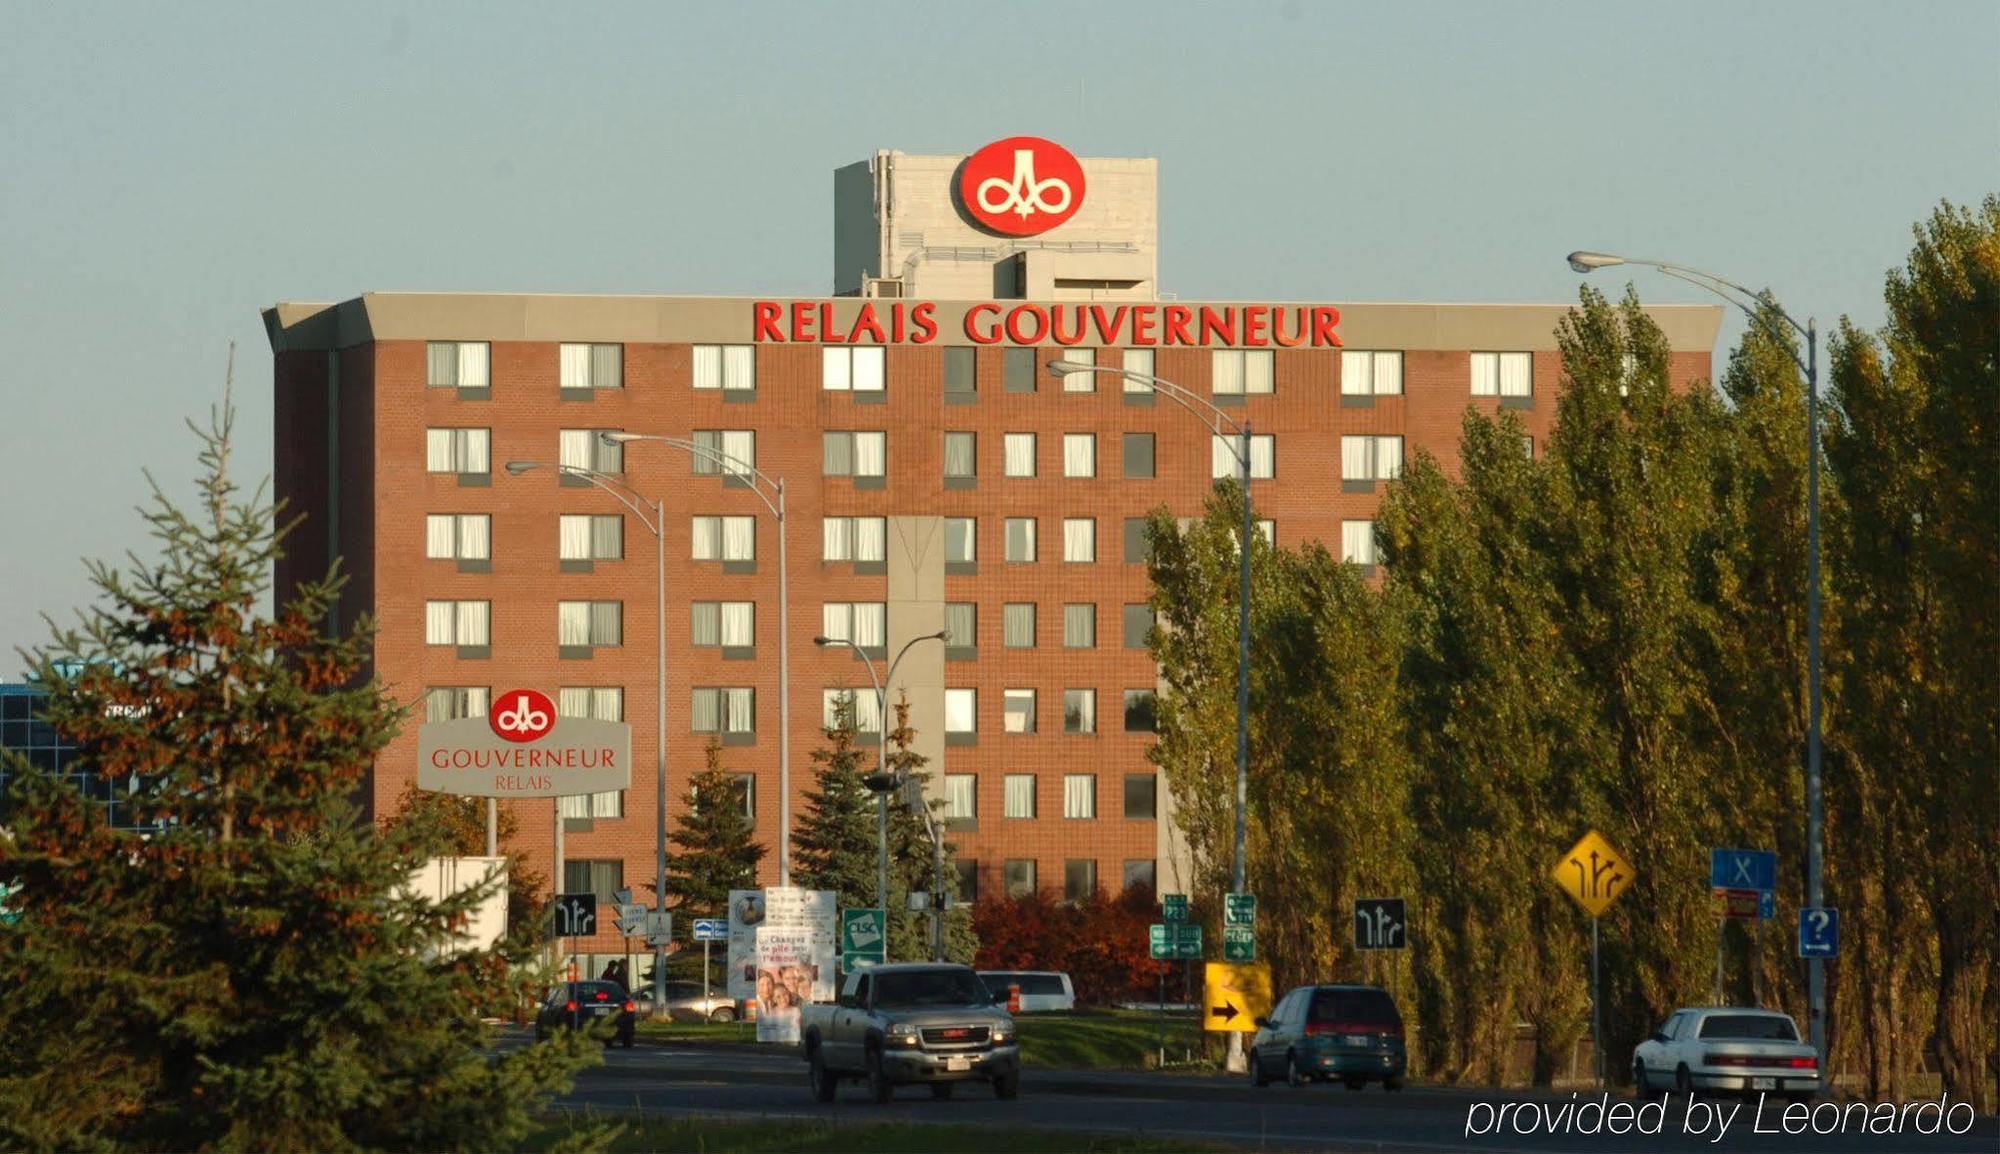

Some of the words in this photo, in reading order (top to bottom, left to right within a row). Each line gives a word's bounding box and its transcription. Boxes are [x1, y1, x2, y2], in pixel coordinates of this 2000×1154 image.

[754, 301, 938, 344] RELAIS
[964, 303, 1343, 347] GOUVERNEUR
[431, 748, 616, 769] GOUVERNEUR
[495, 775, 552, 790] RELAIS
[848, 921, 878, 934] CLSC
